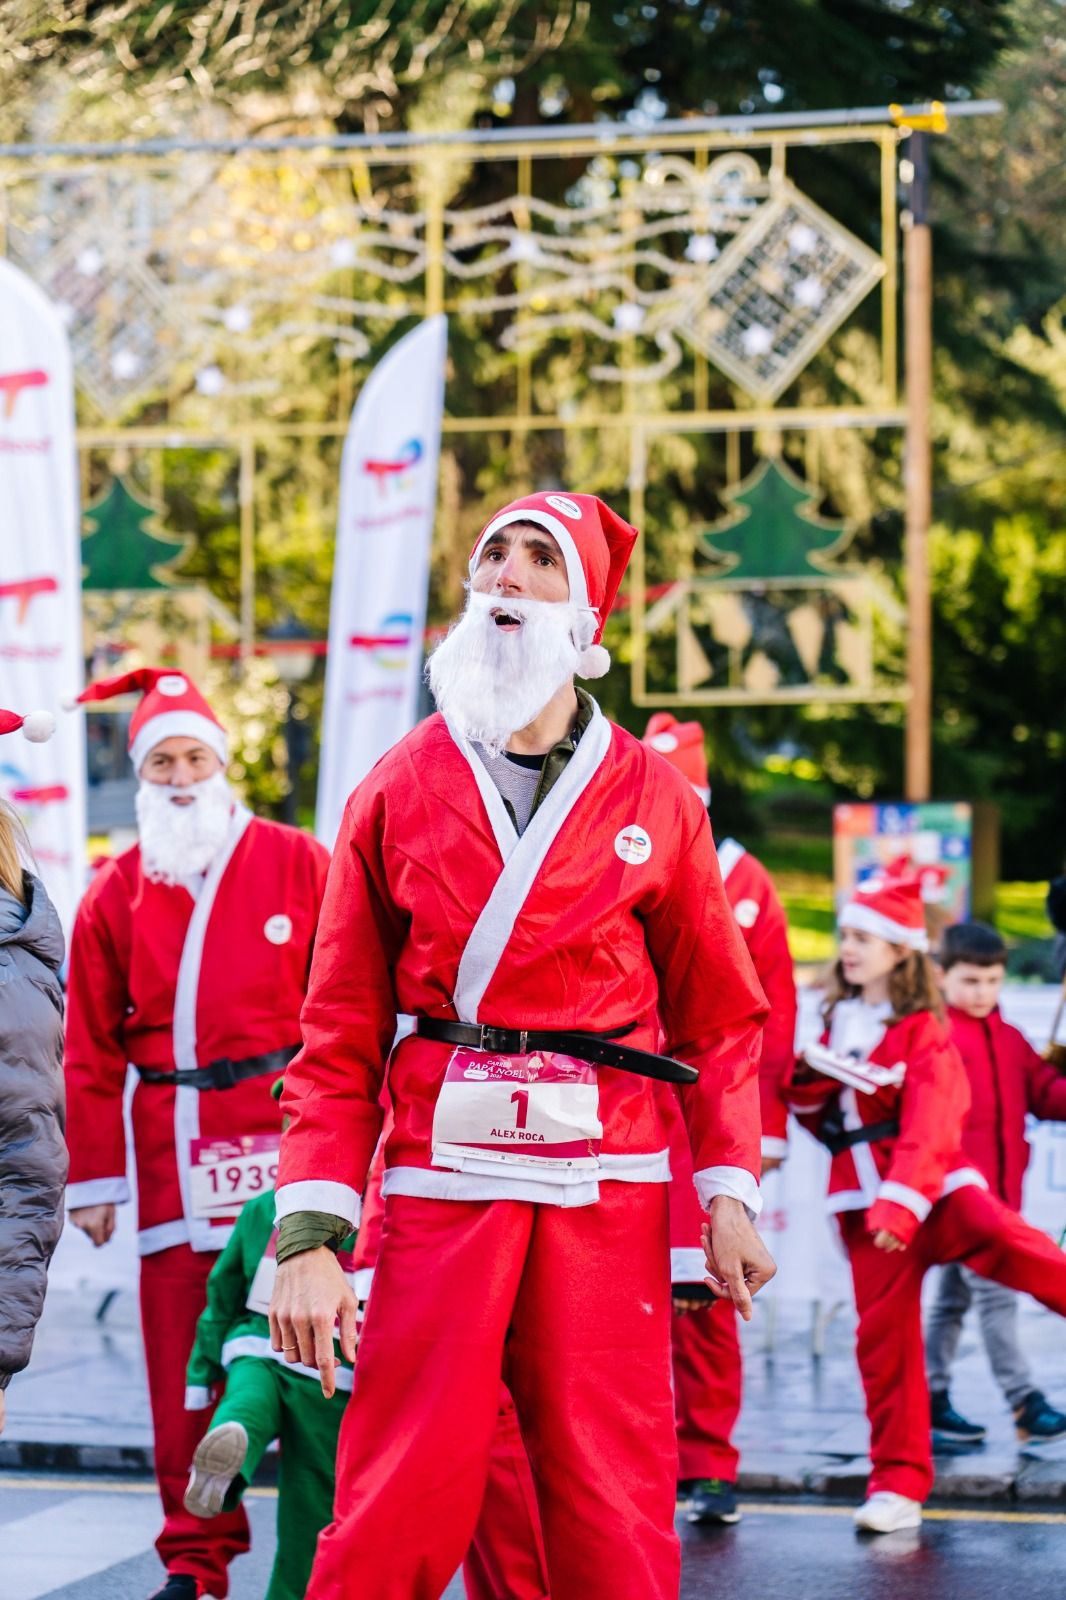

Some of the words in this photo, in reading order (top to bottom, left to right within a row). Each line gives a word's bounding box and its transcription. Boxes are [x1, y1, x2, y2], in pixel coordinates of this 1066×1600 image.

[495, 1067, 525, 1079] NOEL
[511, 1090, 528, 1129] 1
[490, 1127, 516, 1140] ALEX
[518, 1132, 545, 1142] ROCA
